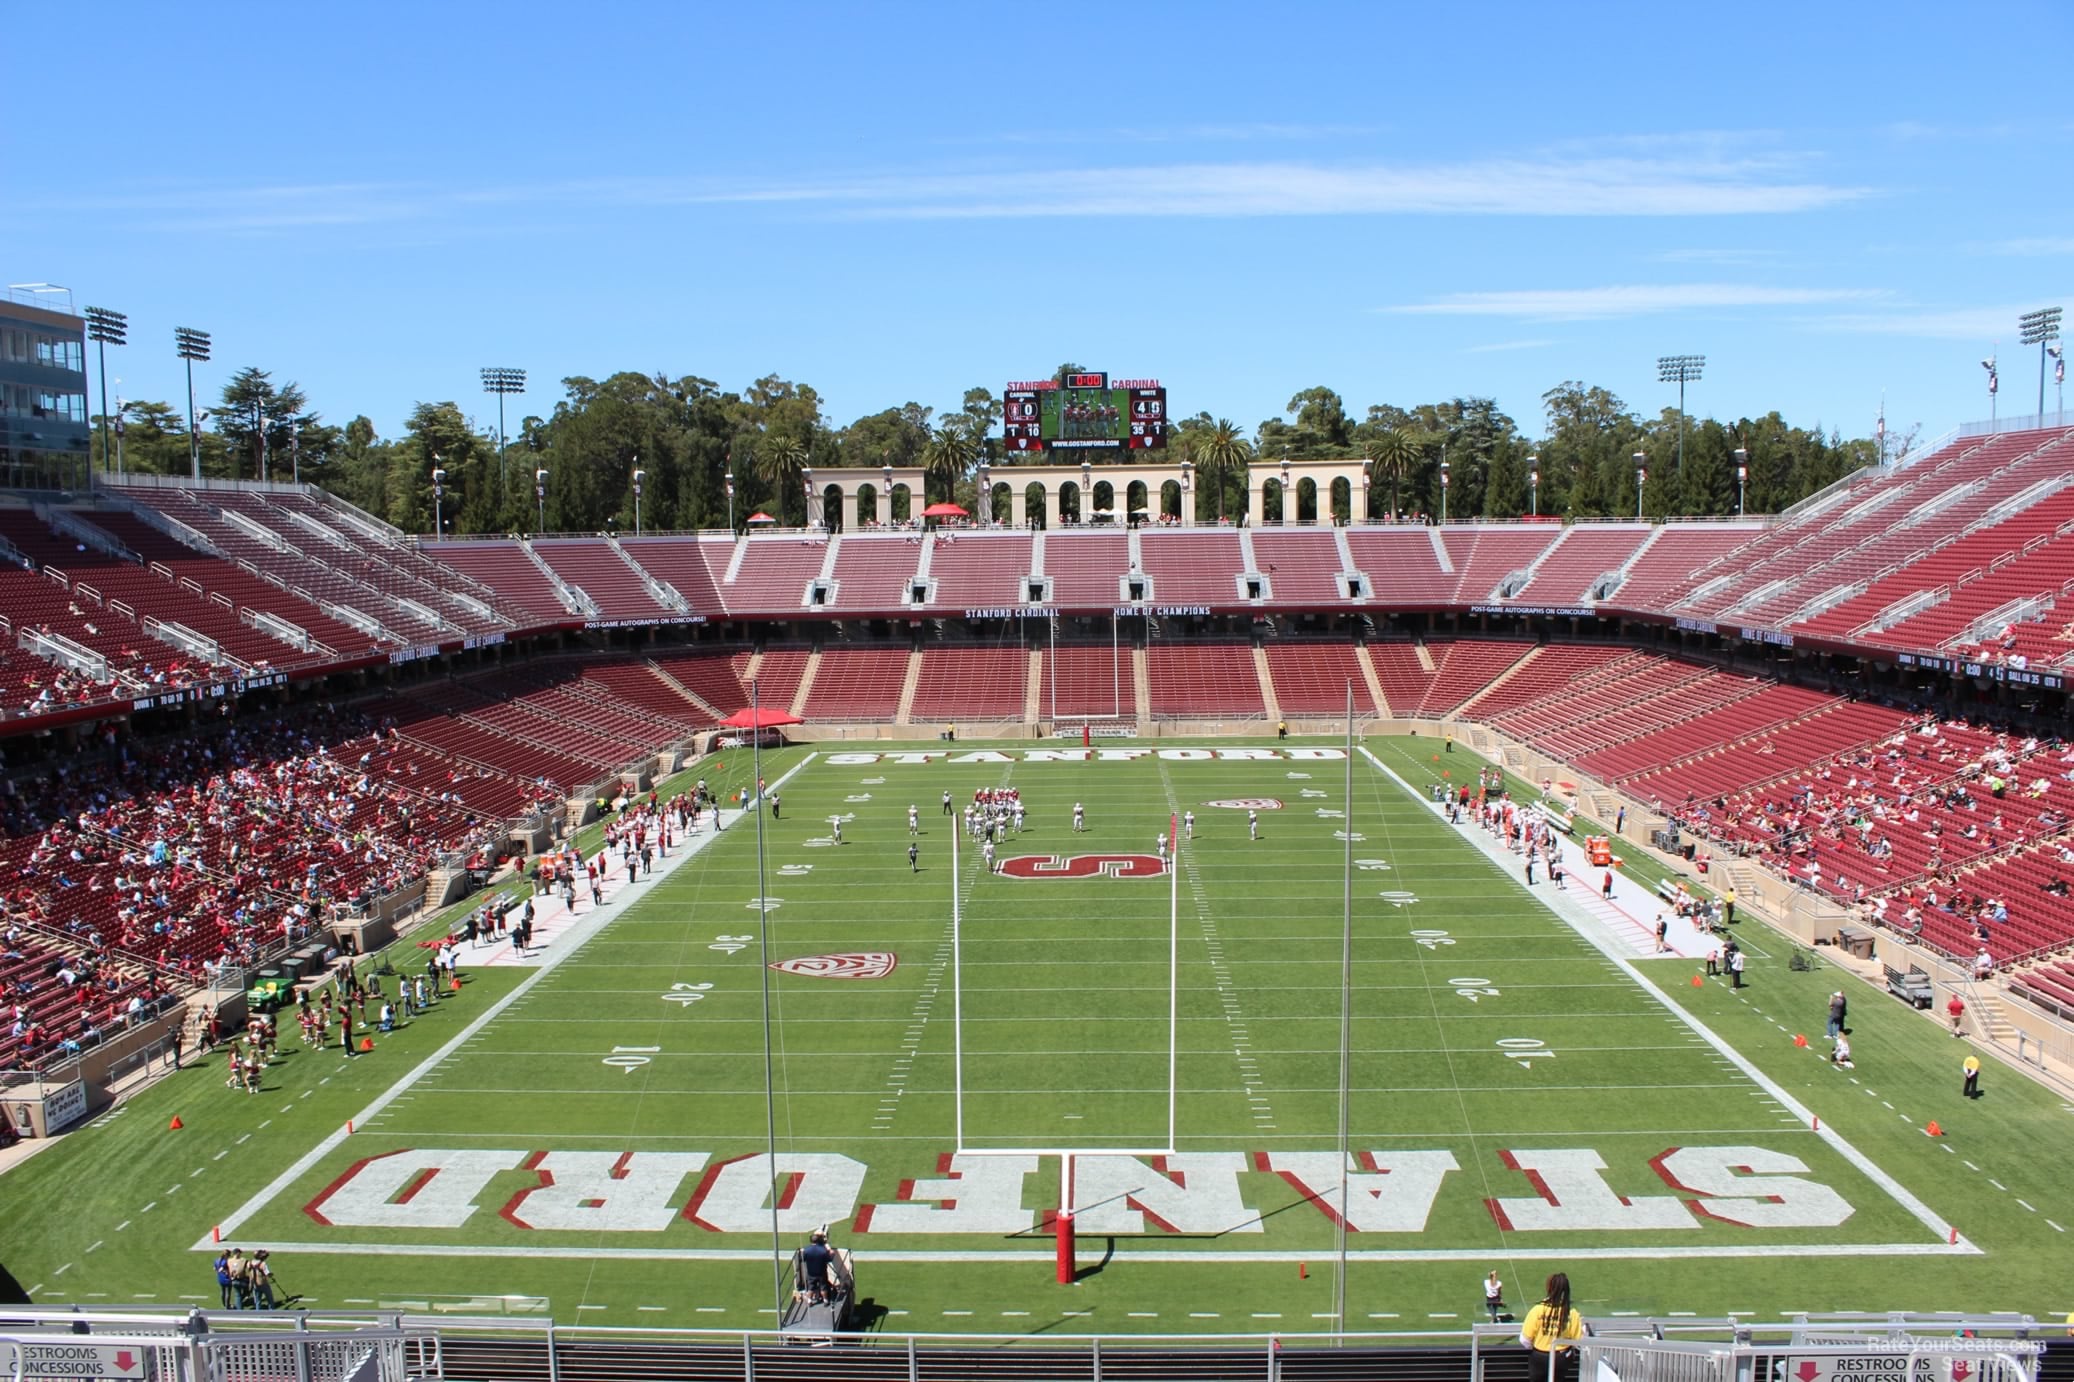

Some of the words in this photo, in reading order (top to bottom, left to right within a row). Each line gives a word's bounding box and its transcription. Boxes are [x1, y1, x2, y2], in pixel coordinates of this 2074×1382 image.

[1076, 375, 1100, 386] 0:00
[1111, 378, 1161, 390] CARDINAL
[1024, 404, 1032, 416] 0
[1138, 402, 1146, 414] 4
[1011, 428, 1015, 437] 1
[1028, 428, 1039, 437] 10
[1132, 426, 1144, 435] 35
[1155, 426, 1160, 434] 1
[1052, 440, 1120, 448] WWW.GOSTANFORD.COM
[966, 608, 1012, 618] STANFORD
[1014, 608, 1060, 618] CARDINAL
[1113, 607, 1139, 616] HOME
[1142, 607, 1154, 616] OF
[1156, 606, 1211, 616] CHAMPIONS
[584, 621, 619, 629] POST-GAME
[620, 619, 659, 627] AUTOGRAPHS
[670, 616, 707, 624] CONCOURSE!
[1966, 664, 1981, 676] 0:00
[1989, 668, 1994, 677] 4
[248, 680, 259, 688] BALL
[266, 676, 272, 685] 35
[2008, 671, 2021, 681] BALL
[2032, 674, 2039, 684] 35
[211, 685, 224, 697] 0:00
[824, 748, 1348, 765] STANFORD
[776, 864, 814, 875] 50
[993, 854, 1172, 879] S
[1354, 860, 1391, 870] 50
[1380, 891, 1420, 903] 40
[708, 935, 753, 950] 30
[1410, 930, 1456, 945] 30
[661, 983, 714, 1001] 20
[1448, 978, 1501, 996] 20
[1496, 1038, 1556, 1058] 10
[602, 1046, 661, 1066] 10
[304, 1146, 1855, 1235] STANFORD
[1831, 1374, 1935, 1382] CONCESSINS
